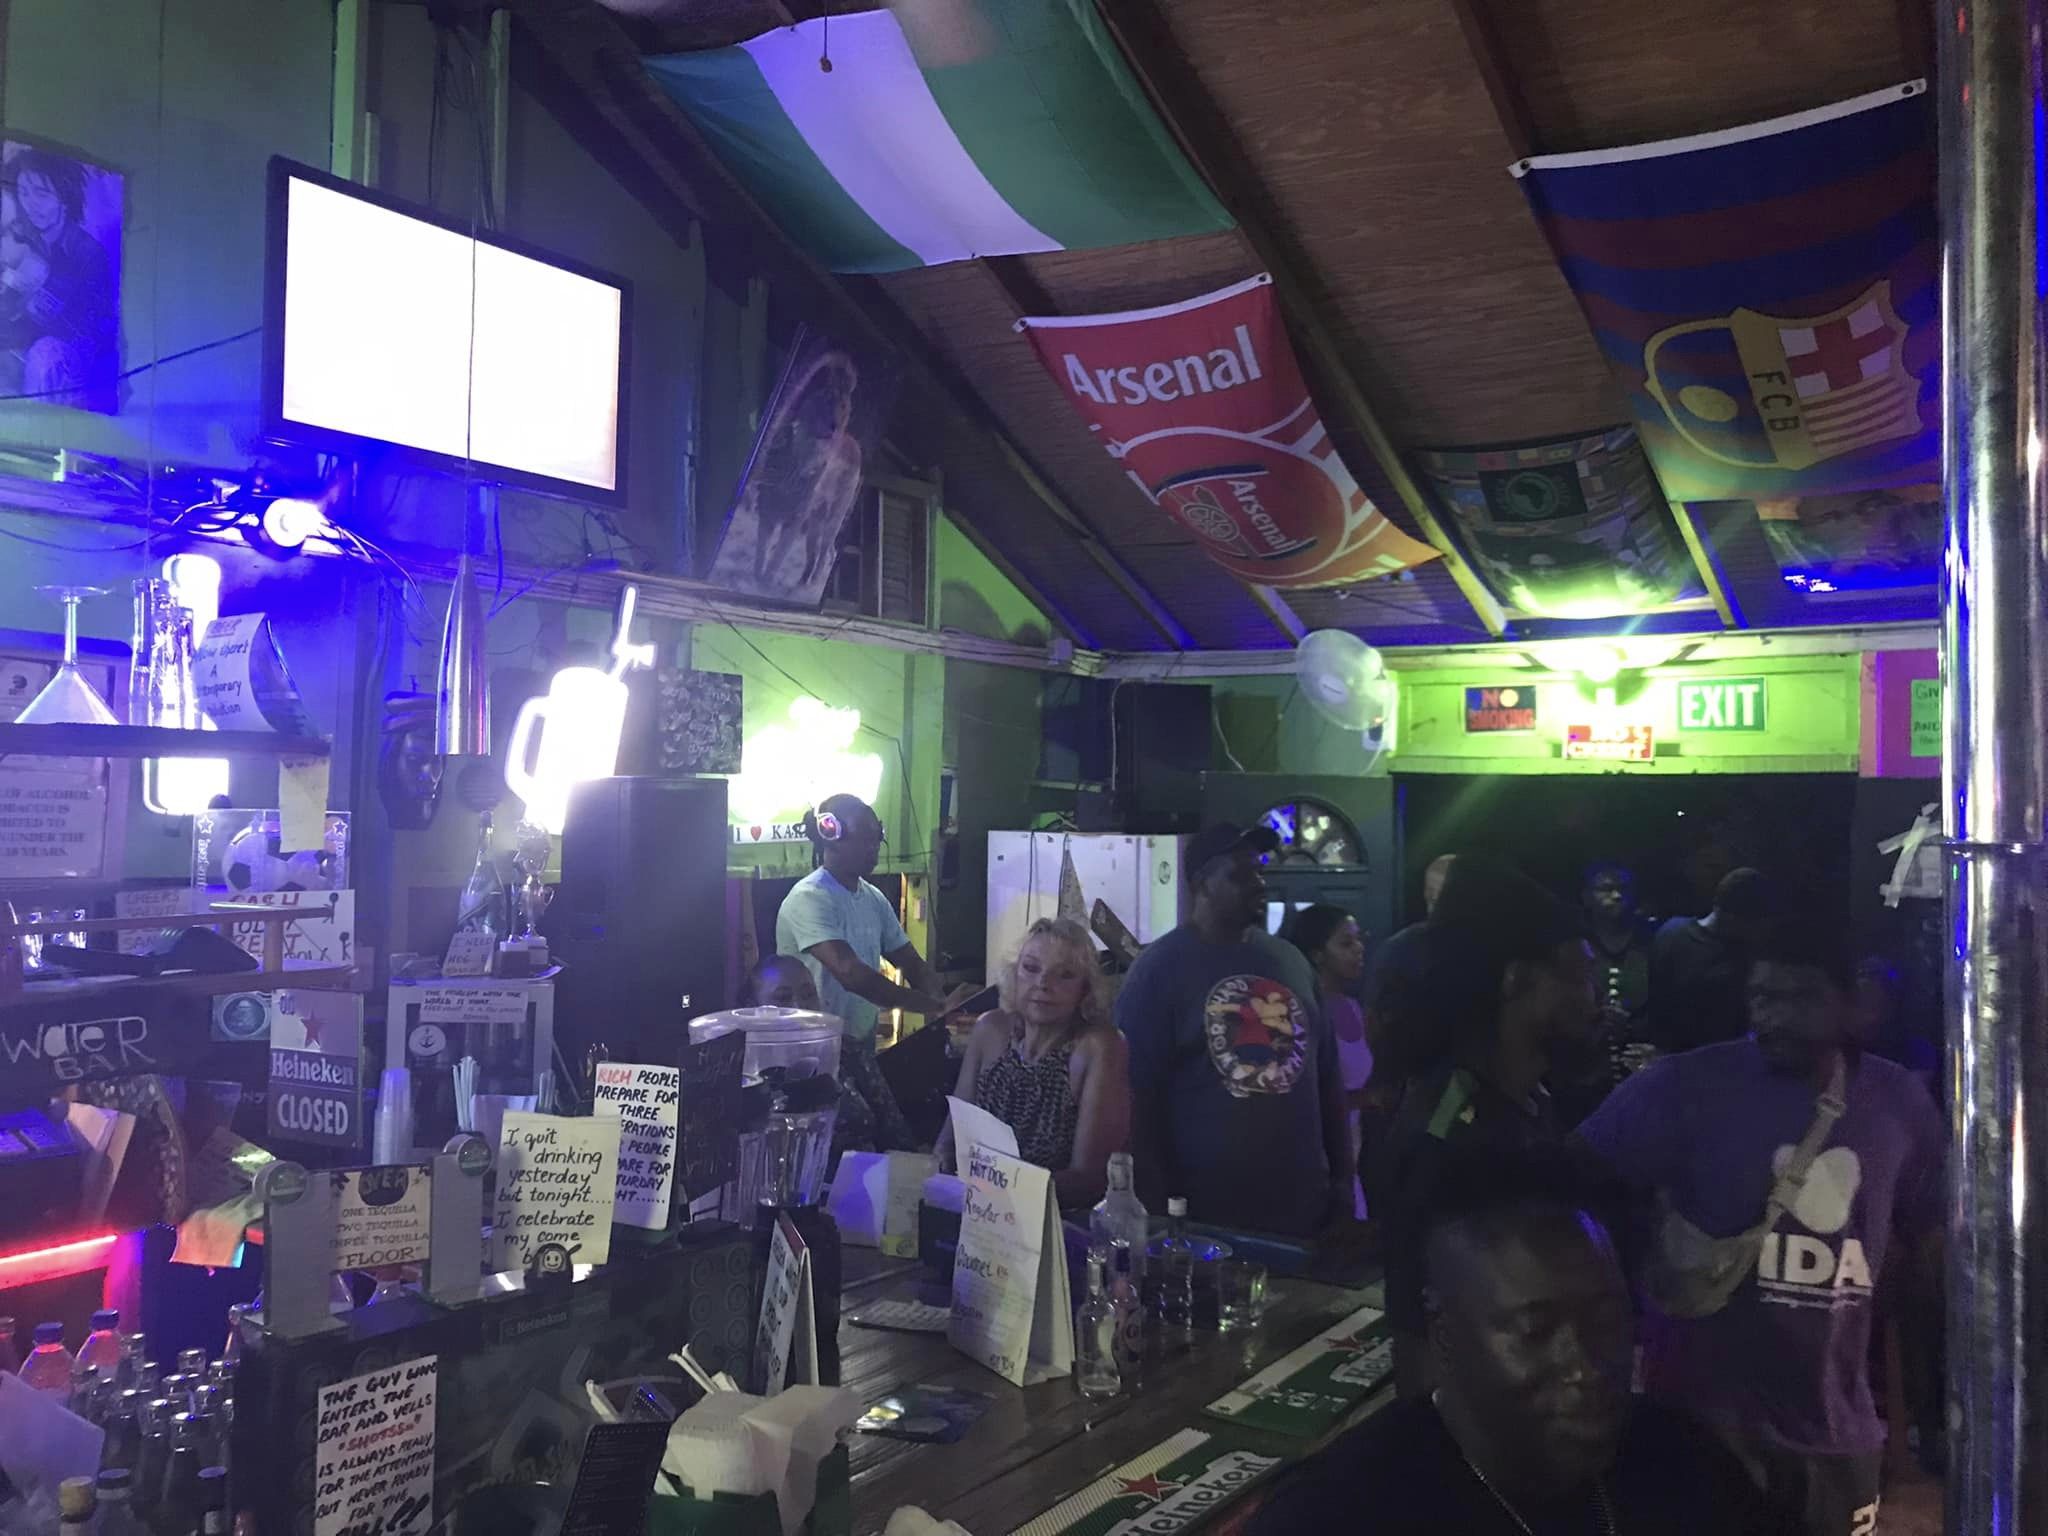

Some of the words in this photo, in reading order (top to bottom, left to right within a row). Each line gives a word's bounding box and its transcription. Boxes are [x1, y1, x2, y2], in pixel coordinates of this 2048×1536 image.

[1063, 325, 1263, 406] Arsenal
[1752, 371, 1799, 432] FCB
[1227, 479, 1300, 553] Arsenal
[1682, 684, 1760, 727] EXIT
[272, 1053, 354, 1086] Heineken
[597, 1069, 632, 1085] RICH
[637, 1070, 679, 1089] PEOPLE
[595, 1085, 649, 1103] PREPARE
[655, 1090, 678, 1105] FOR
[277, 1094, 349, 1136] CLOSED
[618, 1104, 660, 1121] THREE
[503, 1128, 520, 1146] I
[524, 1128, 558, 1151] quit
[620, 1119, 675, 1140] ERATIONS
[534, 1146, 602, 1175] drinking
[628, 1140, 671, 1158] PEOPLE
[509, 1168, 591, 1191] yesterday
[648, 1163, 671, 1177] FOR
[987, 1166, 1009, 1189] DOG
[498, 1186, 522, 1203] but
[616, 1174, 665, 1192] TURDAY
[343, 1208, 364, 1218] ONE
[494, 1211, 511, 1229] I
[516, 1210, 595, 1226] celebrate
[336, 1223, 362, 1233] TWO
[504, 1233, 530, 1248] my
[537, 1231, 580, 1243] come
[324, 1384, 358, 1407] THE
[366, 1371, 401, 1392] GUY
[320, 1399, 376, 1426] ENTERS
[384, 1384, 415, 1404] THE
[319, 1423, 351, 1443] BAR
[355, 1411, 388, 1432] AND
[393, 1393, 432, 1420] YELLS
[318, 1463, 334, 1478] IS
[338, 1445, 395, 1472] ALWAYS
[400, 1432, 433, 1451] READY
[317, 1478, 345, 1498] FOR
[350, 1471, 371, 1486] THE
[373, 1449, 433, 1478] ATTENTION
[316, 1500, 342, 1519] BUT
[347, 1480, 388, 1507] NEVER
[392, 1463, 431, 1488] READY
[349, 1502, 375, 1523] FOR
[383, 1487, 409, 1508] THE
